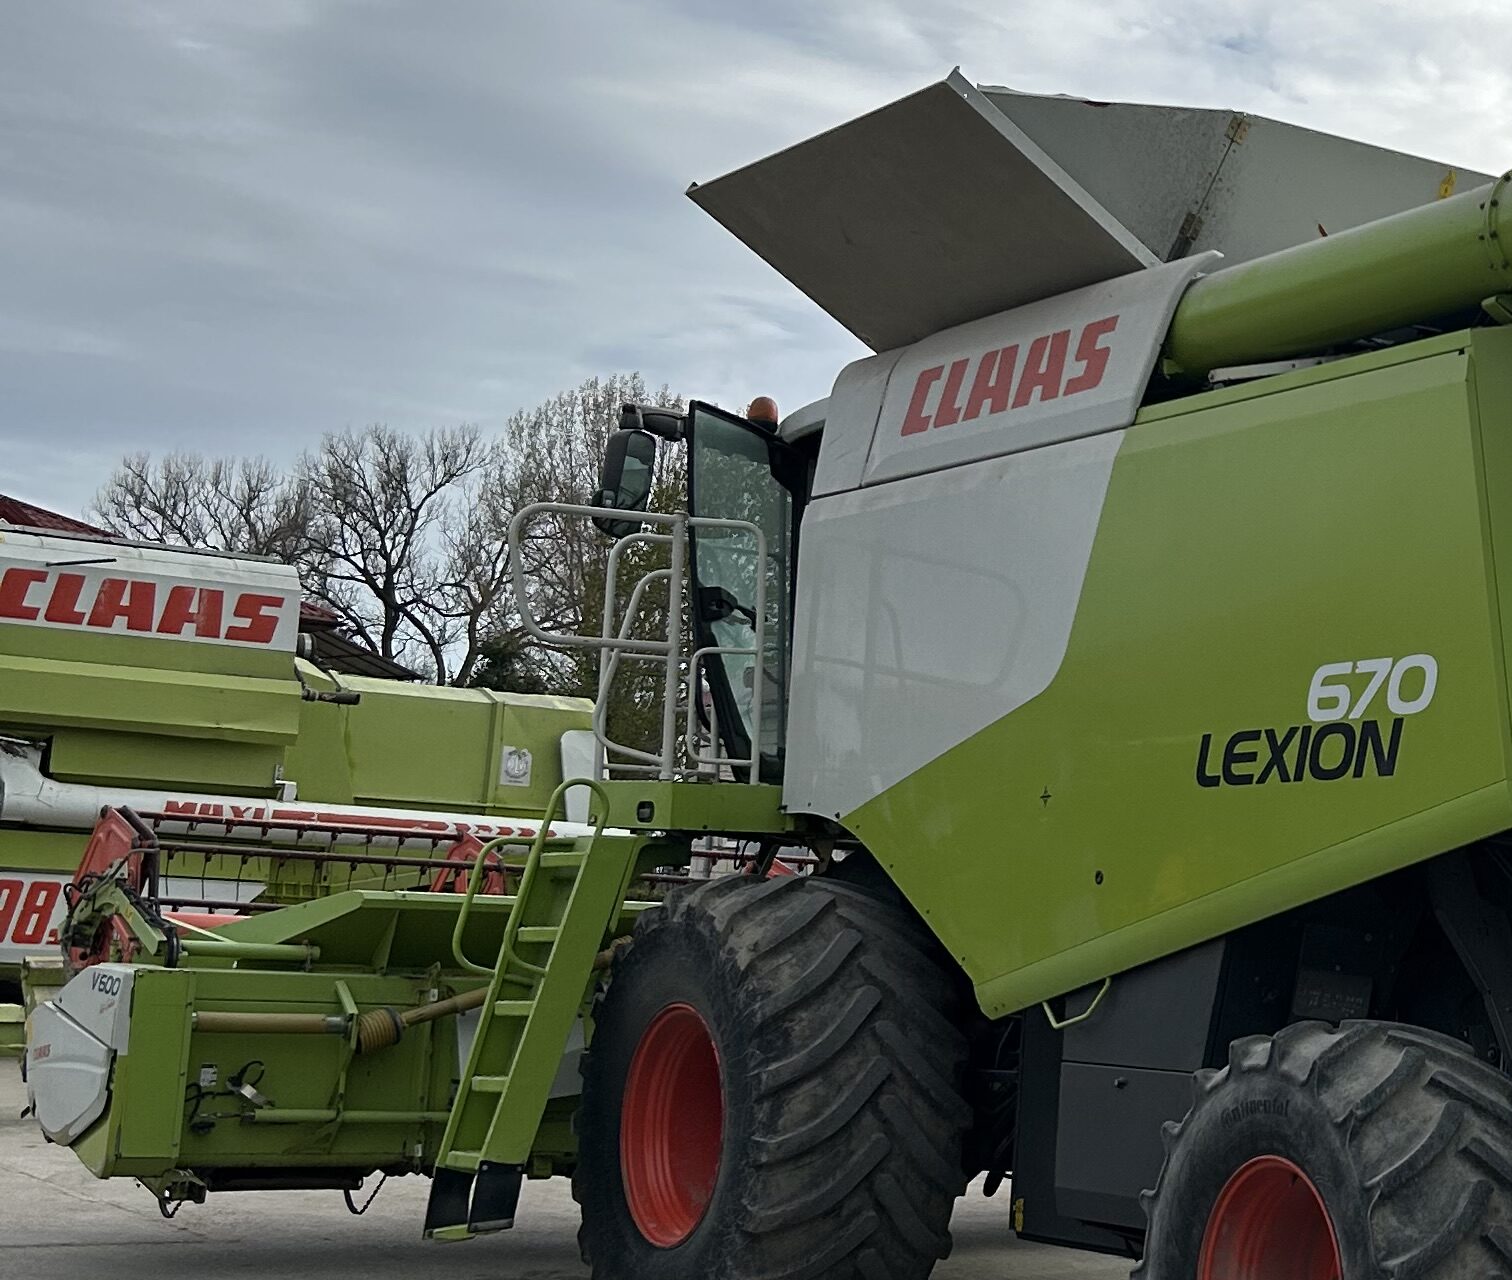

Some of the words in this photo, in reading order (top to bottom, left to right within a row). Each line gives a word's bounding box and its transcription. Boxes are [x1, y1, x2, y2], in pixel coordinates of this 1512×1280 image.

[901, 315, 1121, 437] CLAAS
[0, 567, 285, 643] CLAAS
[1307, 654, 1438, 721] 670
[1196, 718, 1404, 787] LEXION
